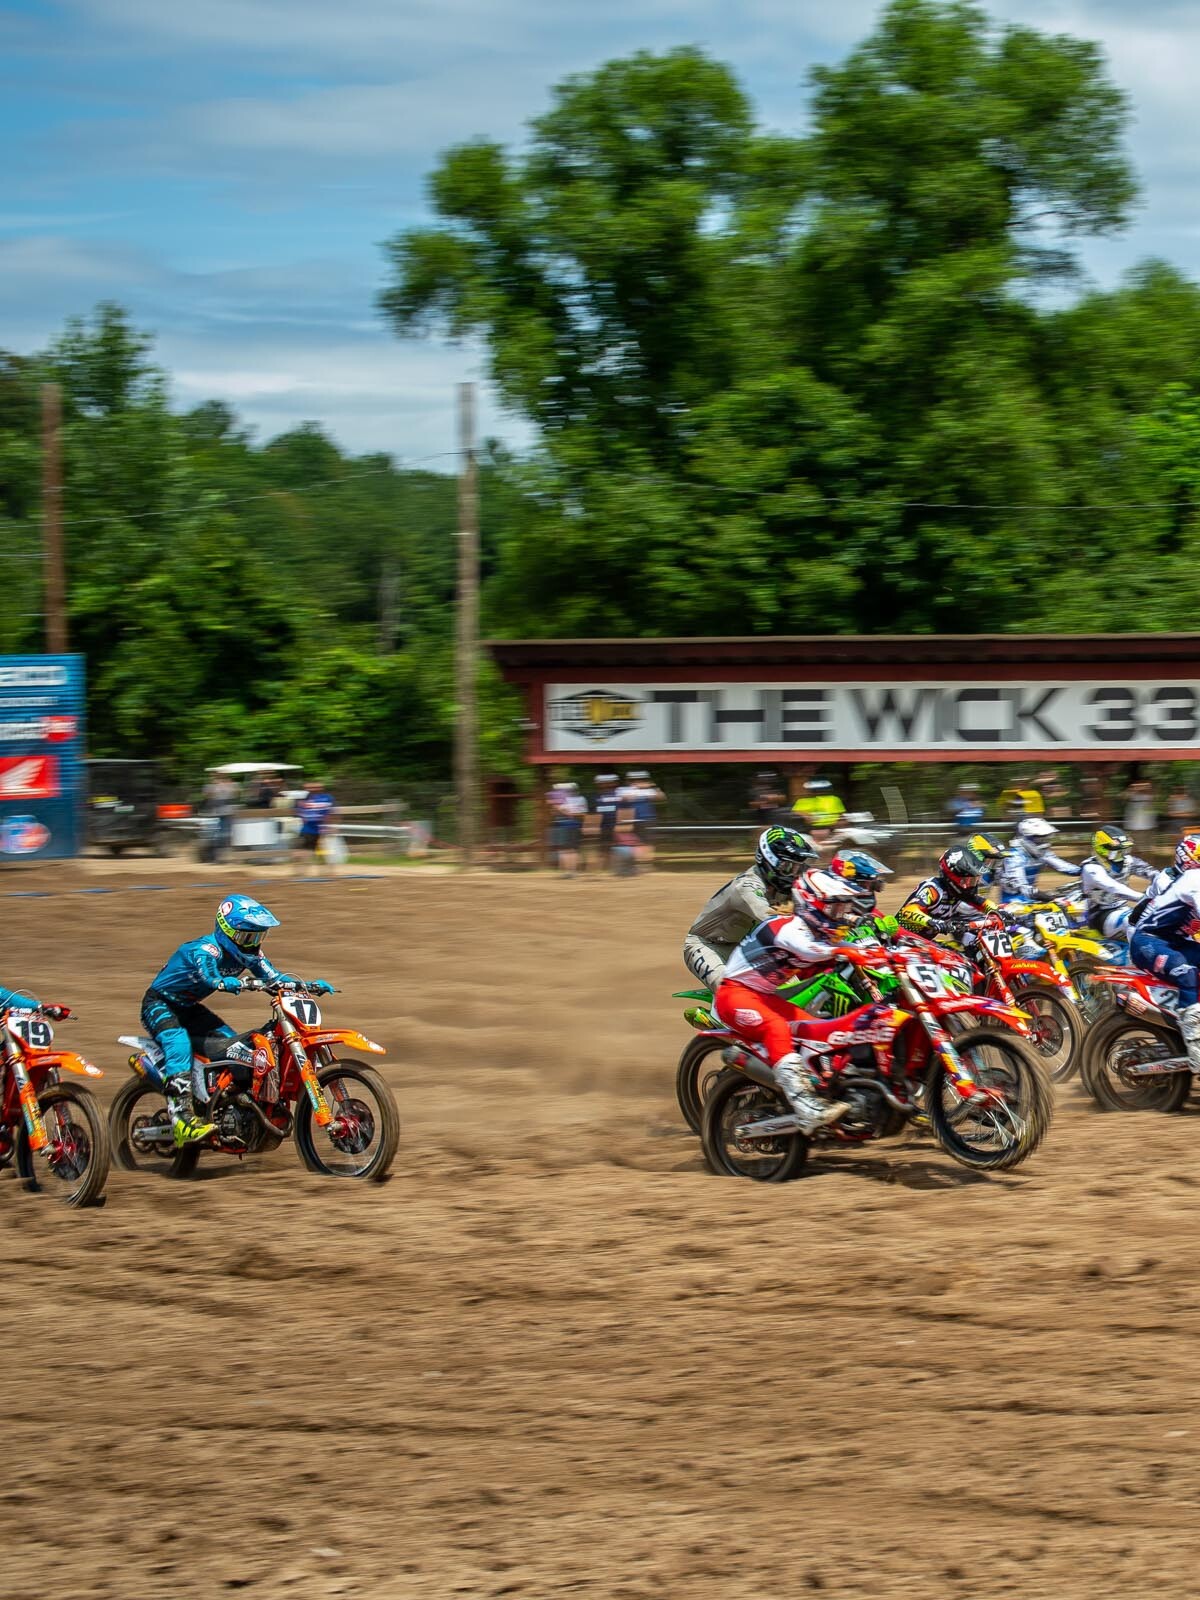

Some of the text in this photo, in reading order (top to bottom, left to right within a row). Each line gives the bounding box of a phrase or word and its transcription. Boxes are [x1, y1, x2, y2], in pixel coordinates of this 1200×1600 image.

[648, 688, 832, 743] THE
[846, 687, 1069, 743] WICK
[988, 933, 1013, 957] 72
[290, 999, 318, 1025] 17
[16, 1020, 50, 1047] 19
